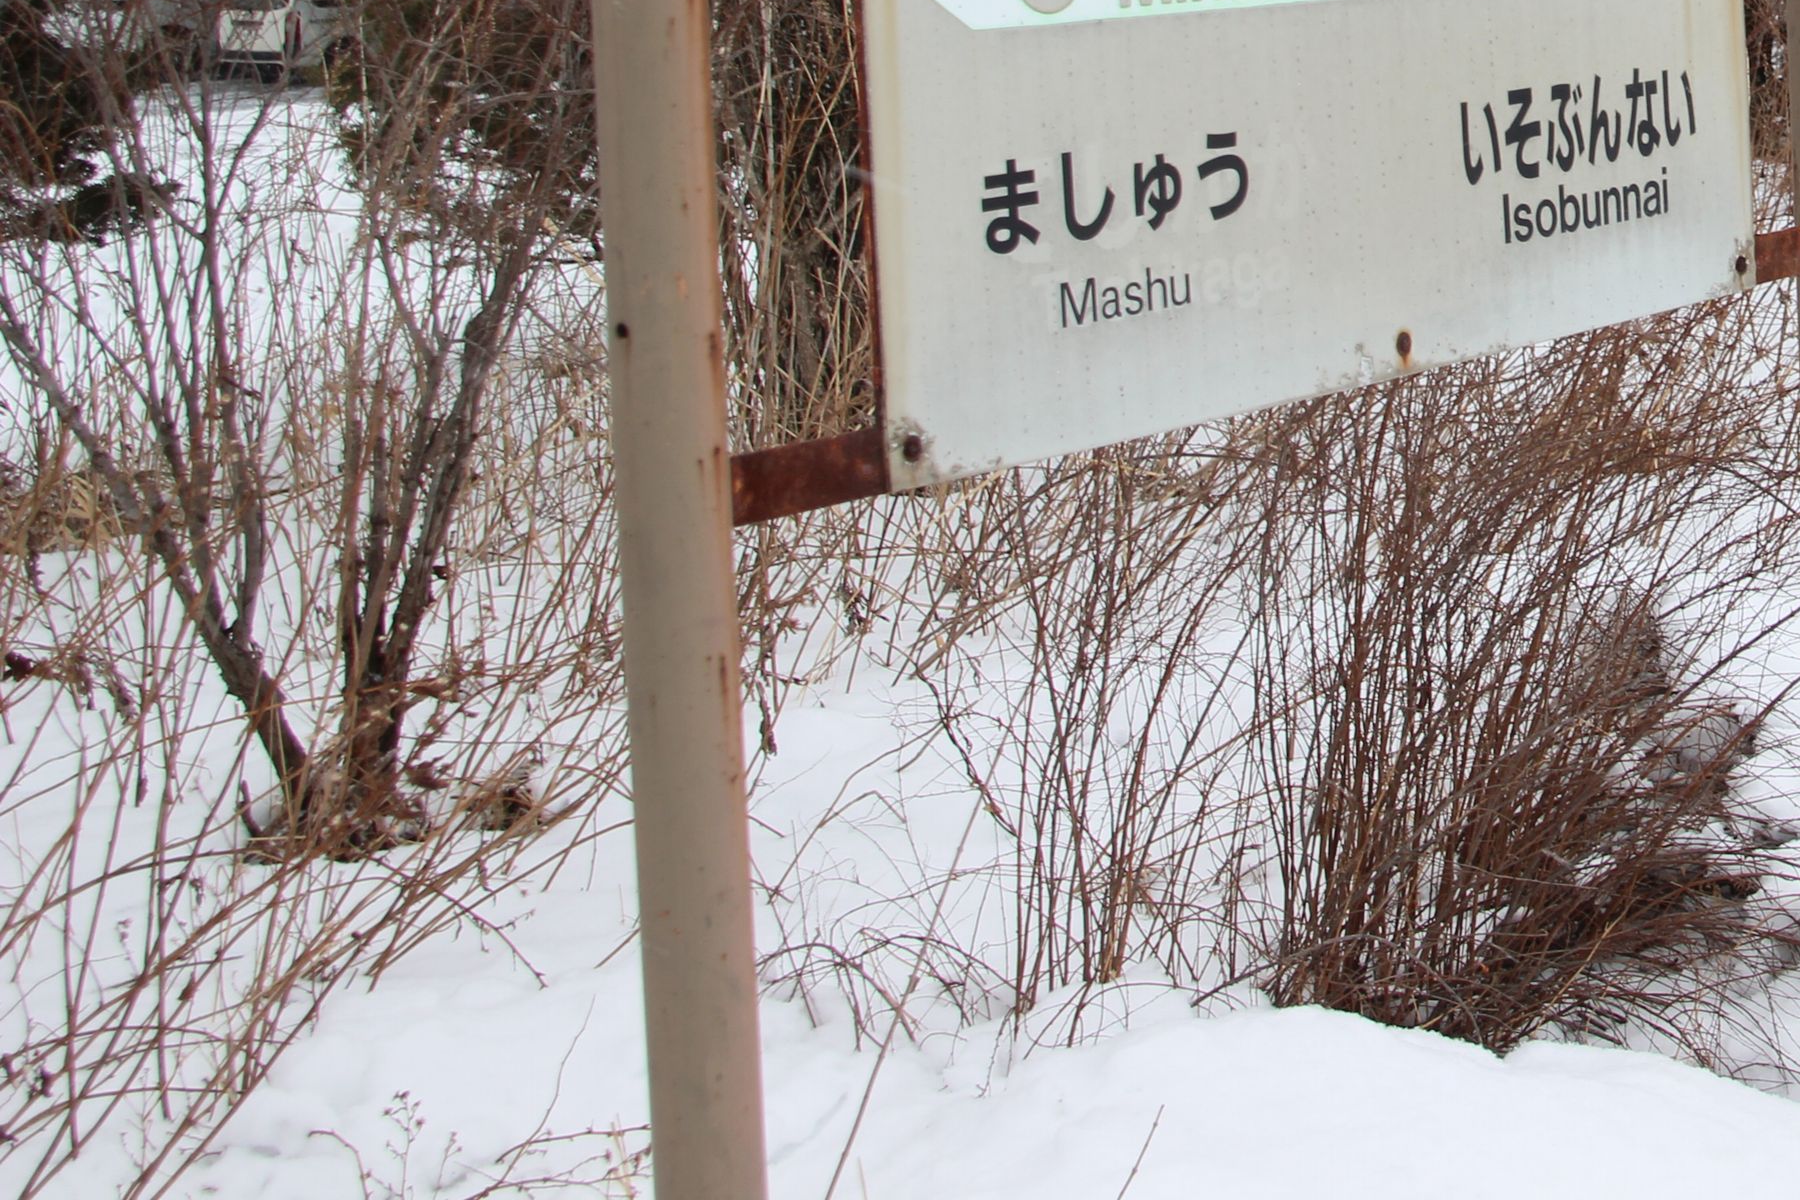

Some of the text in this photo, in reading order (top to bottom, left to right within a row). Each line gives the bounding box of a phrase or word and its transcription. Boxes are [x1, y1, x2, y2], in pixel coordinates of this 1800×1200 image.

[1460, 68, 1697, 186] いそぶんない
[981, 131, 1249, 255] ましゅう
[1502, 166, 1669, 244] Isobunnai
[1060, 267, 1192, 328] Mashu
